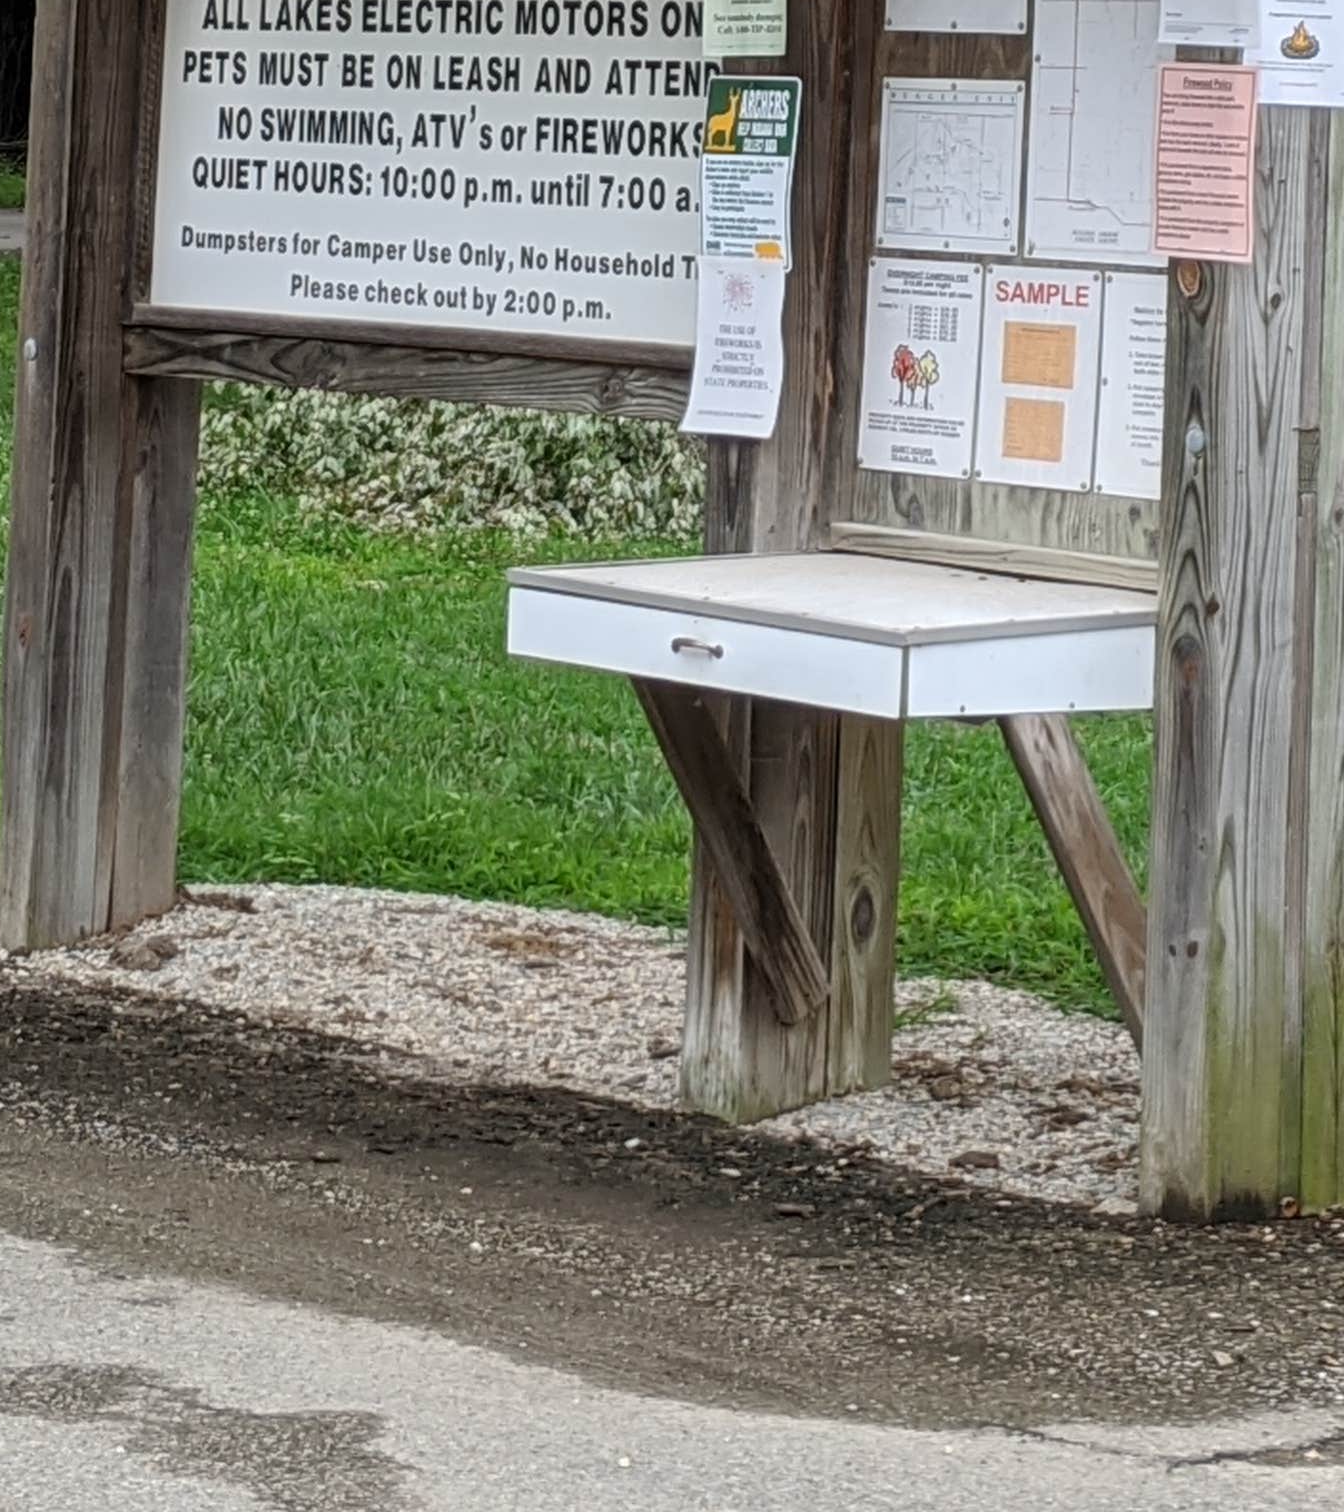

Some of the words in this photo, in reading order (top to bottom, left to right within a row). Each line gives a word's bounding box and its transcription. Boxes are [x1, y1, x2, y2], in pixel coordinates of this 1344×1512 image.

[515, 0, 649, 37] MOTORS
[183, 50, 247, 84] PETS
[259, 52, 329, 86] MUST
[341, 54, 375, 88] BE
[387, 55, 422, 89] ON
[433, 55, 520, 92] LEASH
[534, 58, 591, 94] AND
[739, 89, 791, 120] ARCHERS
[218, 106, 252, 140] NO
[260, 108, 403, 154] SWIMMING,
[500, 125, 527, 152] or
[193, 156, 267, 190] QUIET
[274, 161, 372, 196] HOURS:
[380, 166, 456, 200] 10:00
[464, 176, 522, 208] p.m.
[531, 174, 590, 206] until
[599, 176, 666, 210] 7:00
[181, 225, 287, 254] Dumpsters
[292, 232, 320, 256] for
[327, 234, 407, 264] Camper
[413, 239, 452, 264] Use
[459, 242, 514, 273] Only,
[521, 245, 548, 270] No
[555, 248, 675, 278] Household
[290, 274, 359, 301] Please
[365, 279, 428, 306] check
[434, 286, 467, 309] out
[473, 286, 497, 316] by
[504, 289, 556, 316] 2:00
[563, 299, 612, 322] p.m.
[995, 280, 1090, 308] SAMPLE
